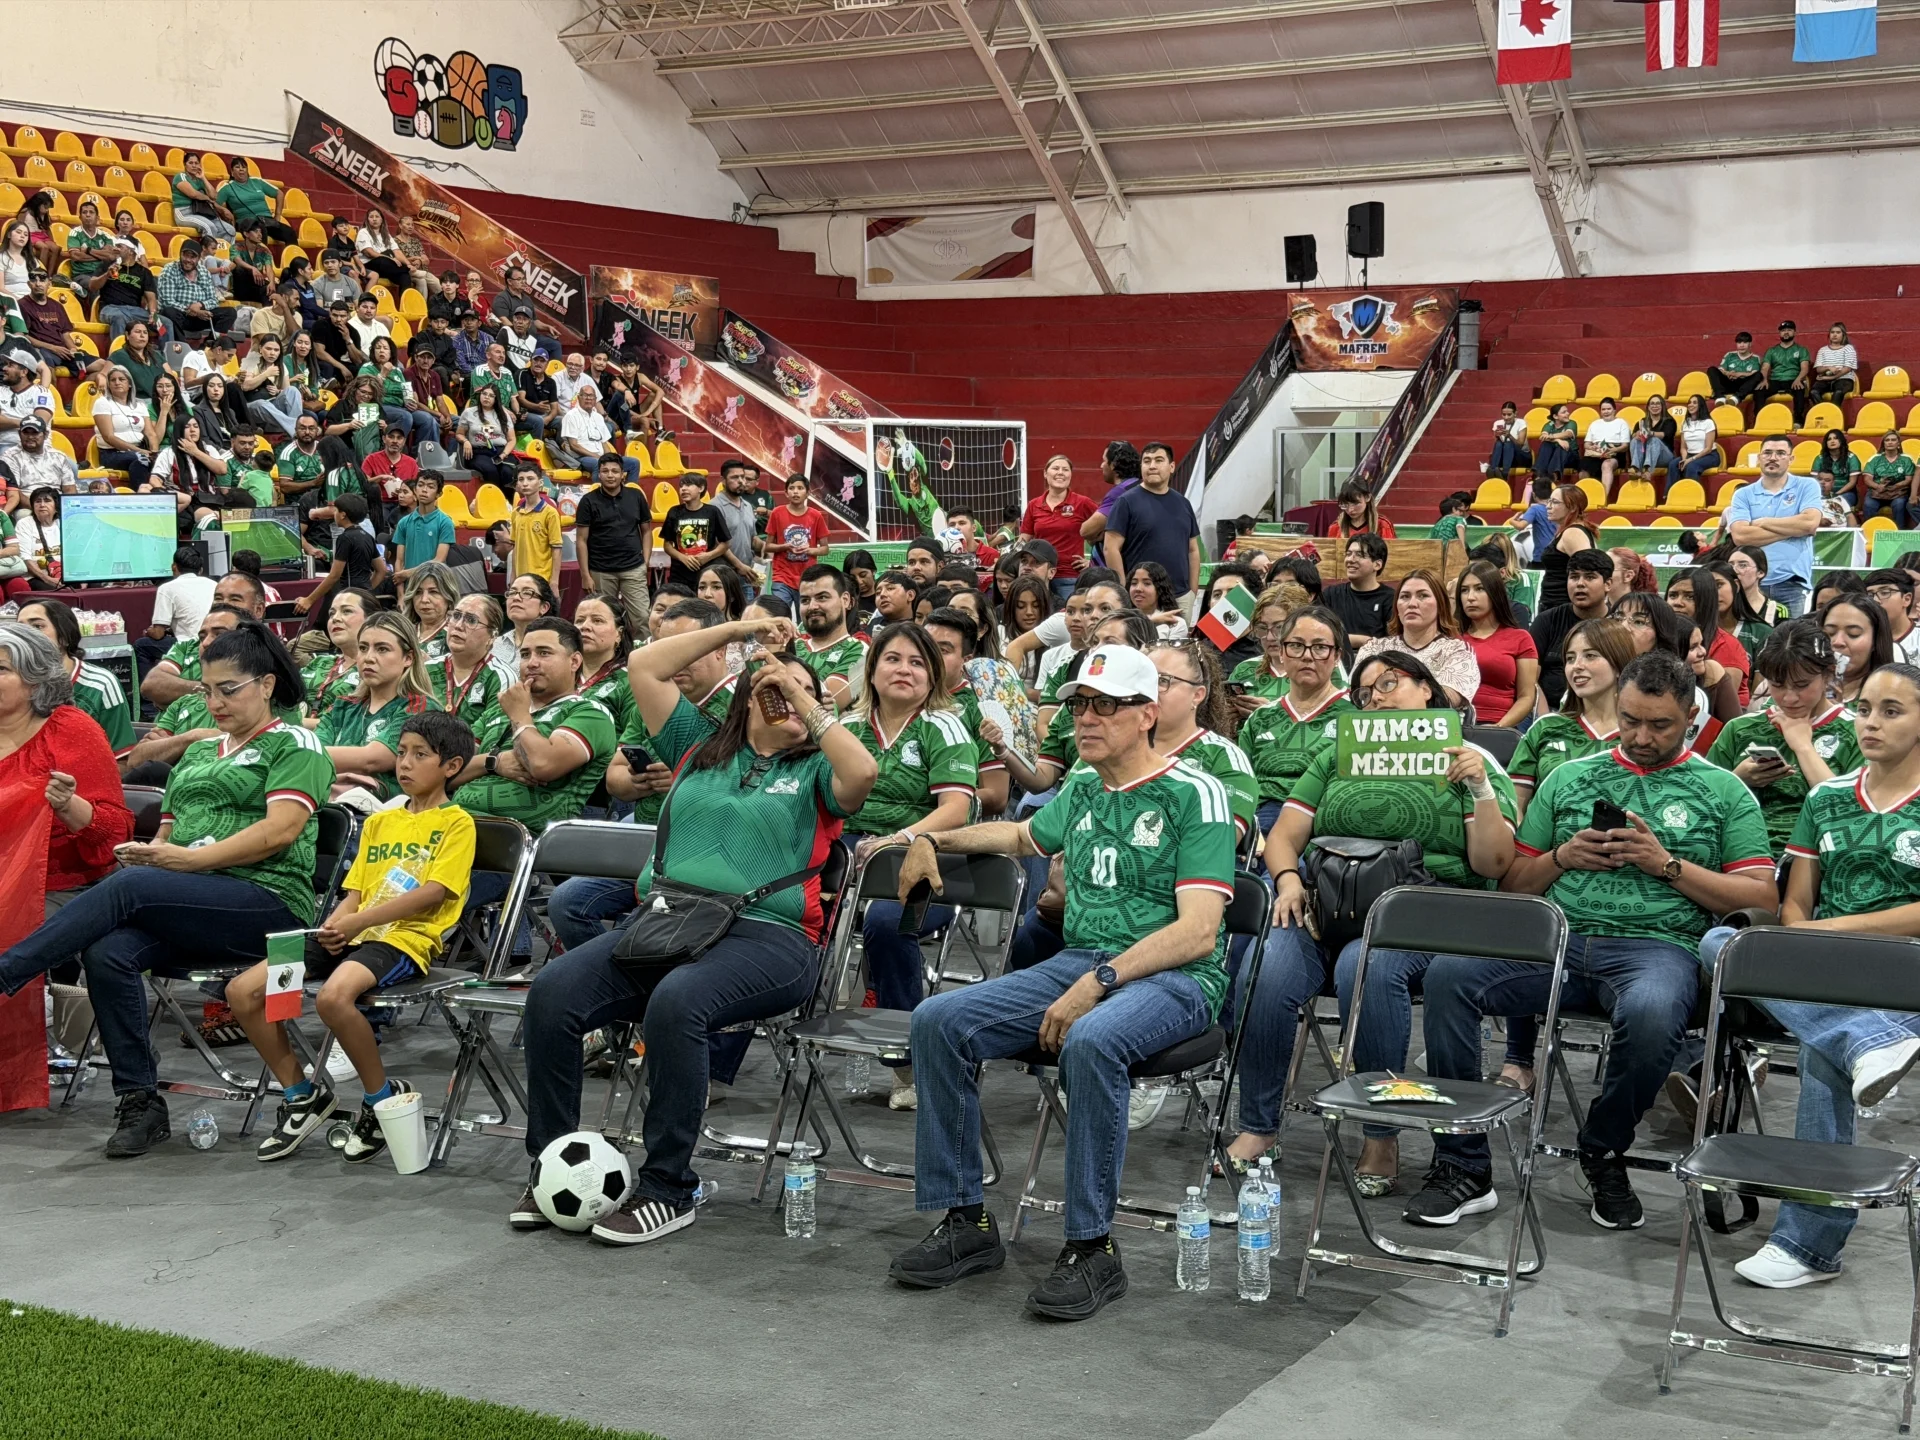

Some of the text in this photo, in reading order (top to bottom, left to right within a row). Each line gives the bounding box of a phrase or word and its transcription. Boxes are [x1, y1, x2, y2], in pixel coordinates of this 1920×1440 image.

[313, 133, 391, 193] SNEEK
[1338, 343, 1388, 354] MAFREM
[1644, 373, 1654, 381] 21
[1886, 367, 1896, 375] 16
[1673, 407, 1683, 416] 20
[1352, 717, 1449, 742] VAMOS
[1350, 745, 1451, 776] MÉXICO
[1091, 846, 1118, 888] 10
